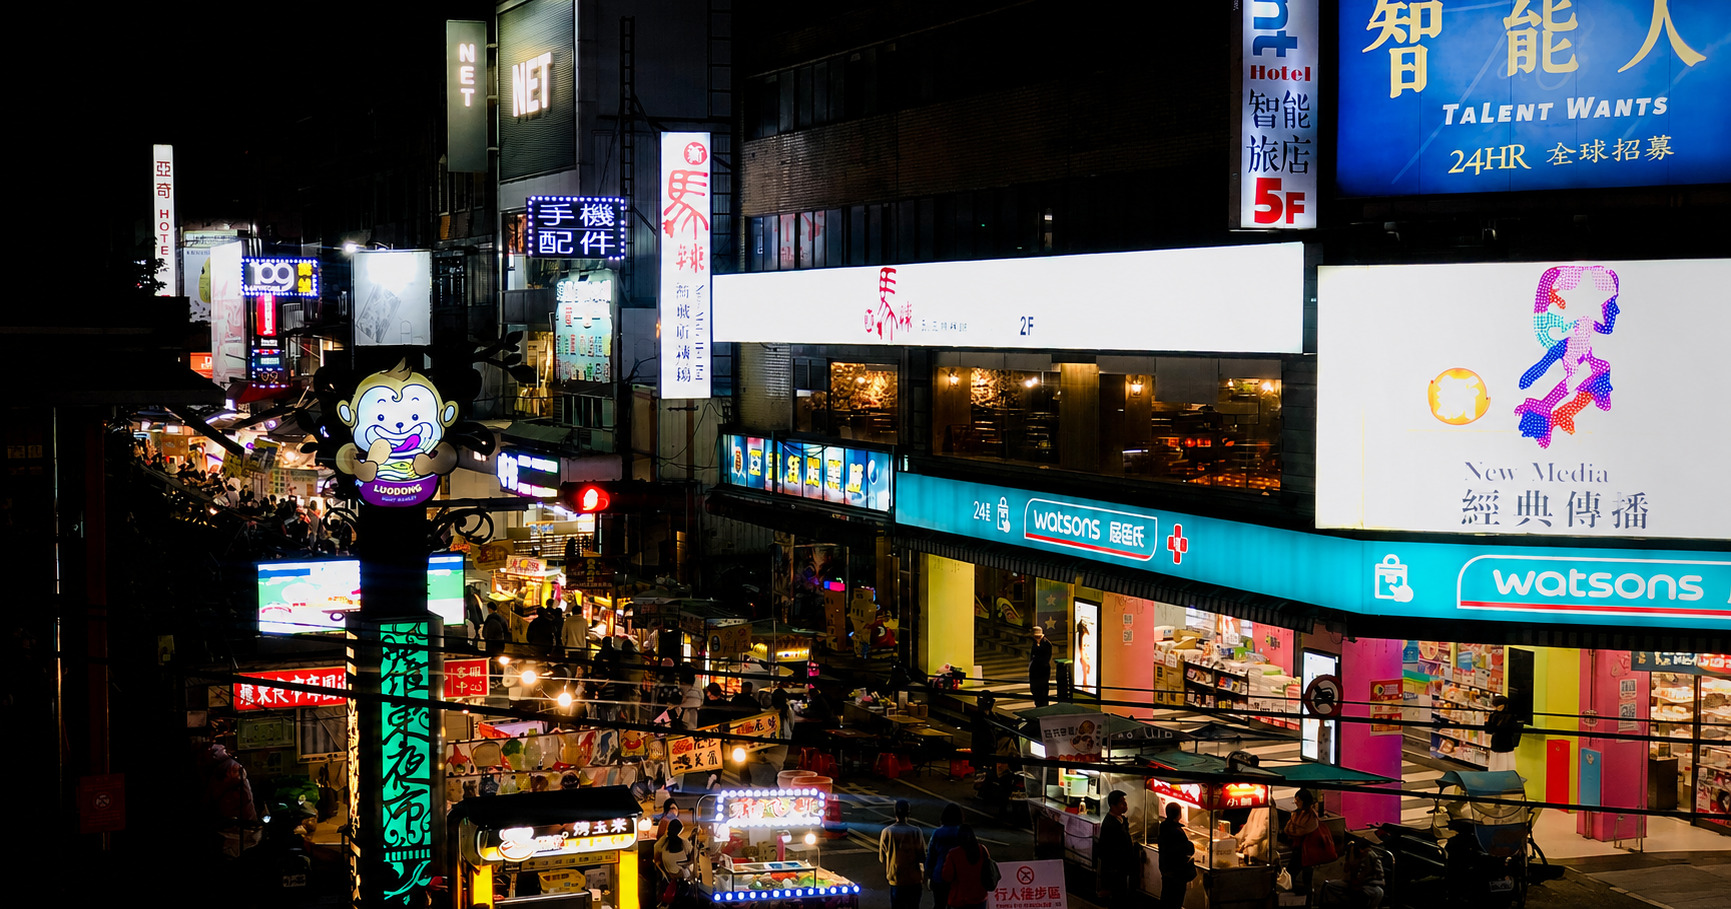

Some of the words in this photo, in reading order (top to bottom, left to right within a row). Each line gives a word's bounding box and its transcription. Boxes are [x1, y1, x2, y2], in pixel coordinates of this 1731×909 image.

[1362, 0, 1706, 99] 智能人
[459, 43, 476, 107] NET
[512, 52, 555, 118] NET
[1250, 65, 1311, 82] Hotel
[1248, 88, 1311, 130] 智能
[1566, 96, 1669, 120] WANTS
[1246, 134, 1311, 175] 旅店
[1448, 143, 1531, 175] 24HR
[1546, 133, 1674, 166] 全球招募
[156, 160, 171, 199] 亞奇
[537, 203, 615, 227] 手機
[1254, 177, 1306, 224] 5F
[159, 209, 170, 256] HOTE
[538, 230, 616, 255] 配件
[249, 262, 294, 292] 109
[1019, 315, 1035, 336] 2F
[373, 484, 422, 495] LUODONG
[1464, 461, 1517, 482] New
[1532, 461, 1609, 483] Media
[1034, 509, 1101, 541] watsons
[1461, 488, 1649, 530] 經典傳播
[1493, 568, 1704, 601] watsons
